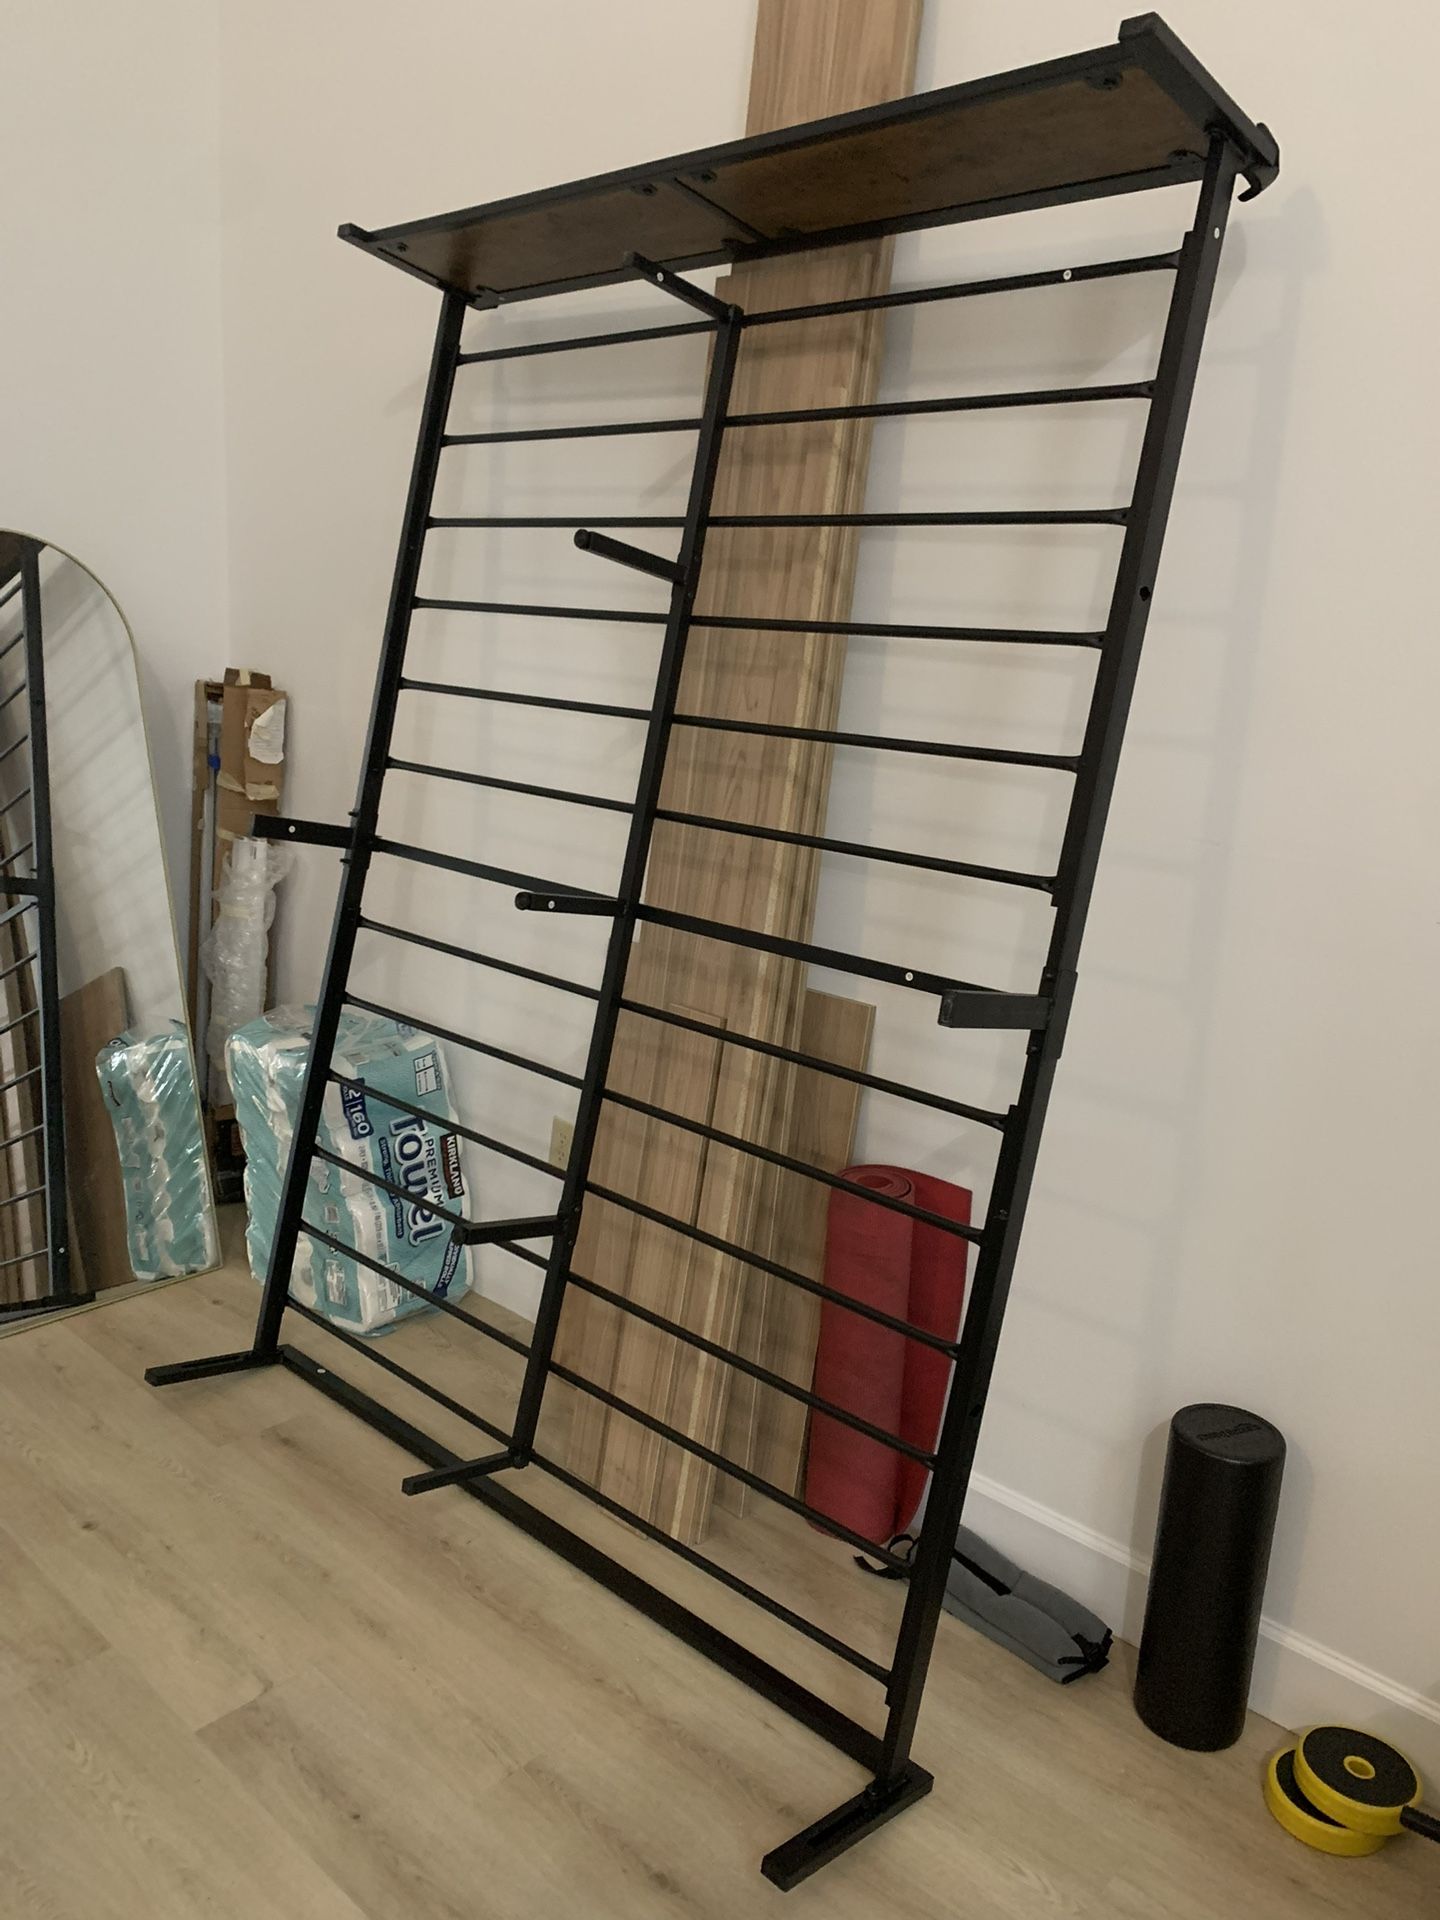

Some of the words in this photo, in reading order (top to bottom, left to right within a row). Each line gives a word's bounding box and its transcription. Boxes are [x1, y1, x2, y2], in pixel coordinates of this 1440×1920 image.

[350, 1104, 370, 1134] 160
[425, 1138, 445, 1208] PREMIUM
[447, 1135, 462, 1194] KIRKLAND
